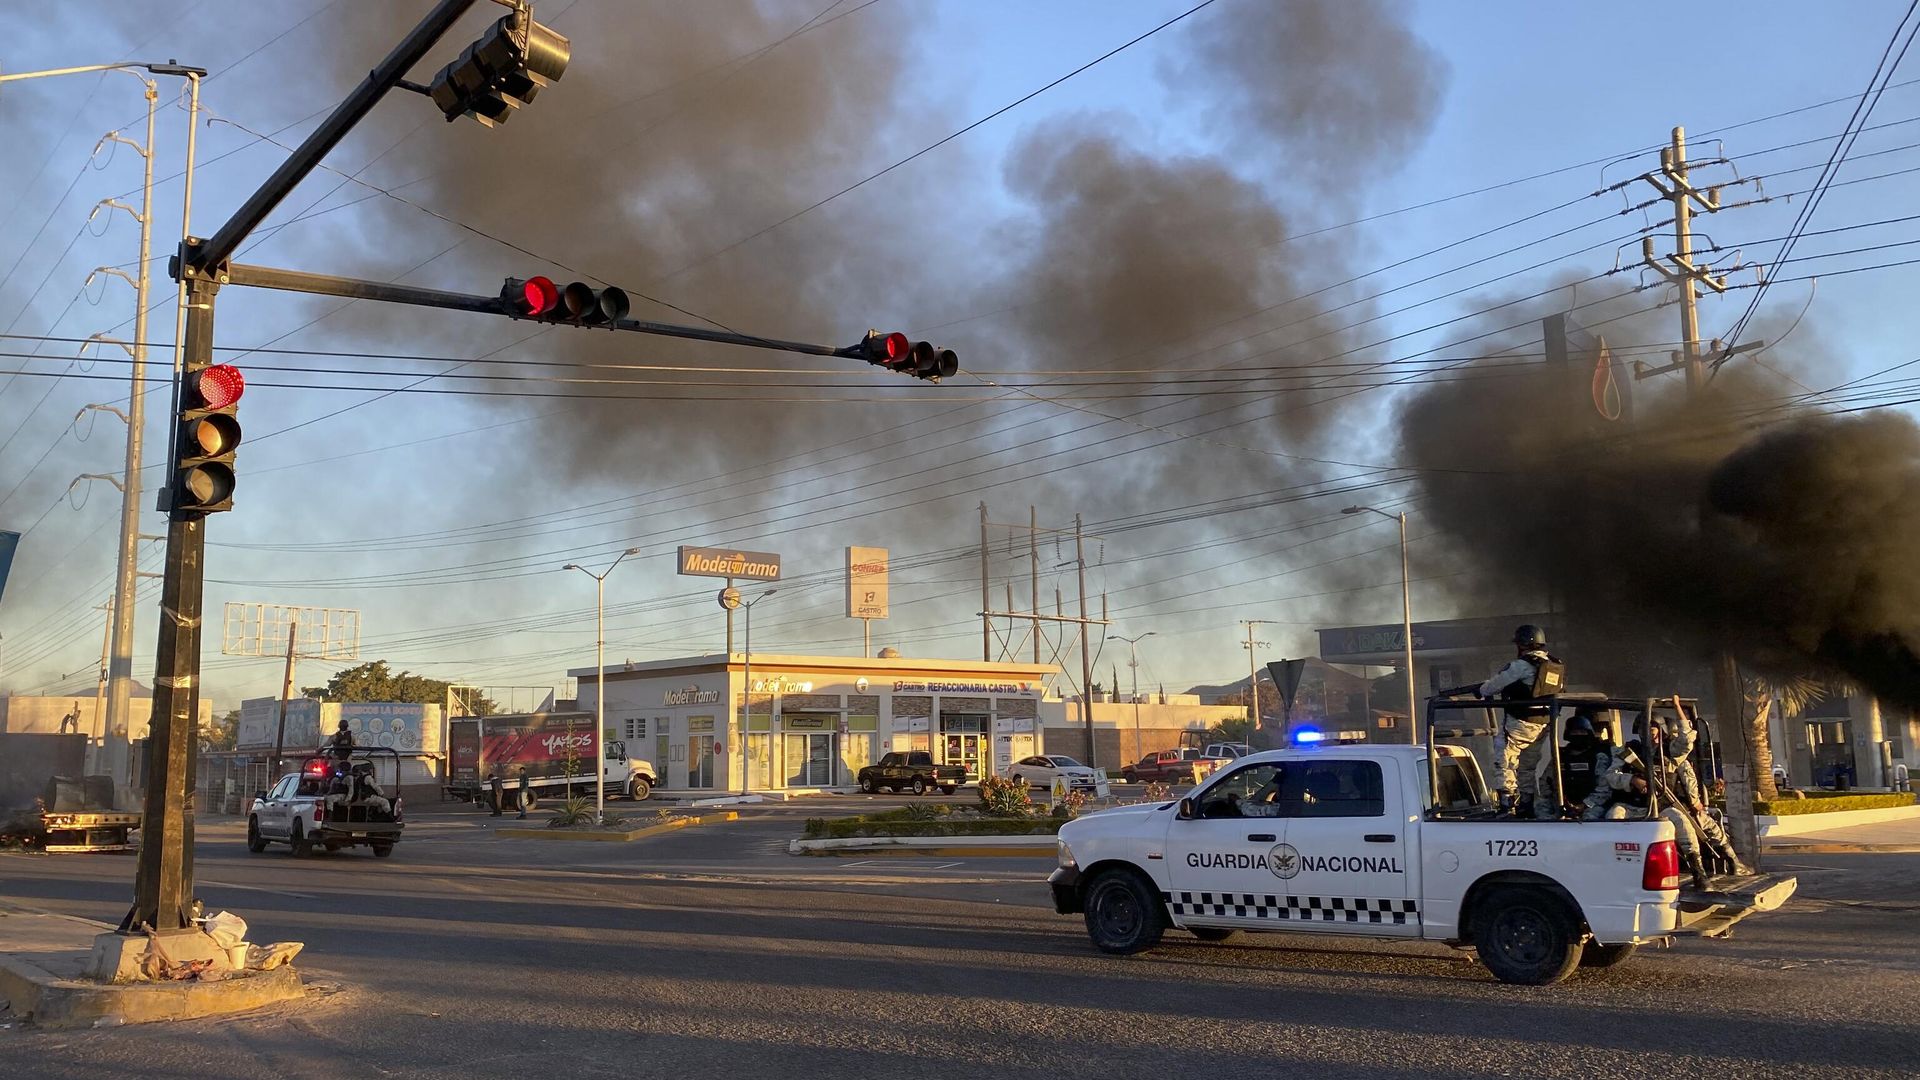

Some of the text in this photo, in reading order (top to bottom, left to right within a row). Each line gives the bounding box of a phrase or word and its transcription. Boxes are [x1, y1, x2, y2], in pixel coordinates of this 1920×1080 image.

[858, 607, 882, 615] CASTRO
[927, 682, 987, 693] REFACCIONARIA
[989, 683, 1018, 694] CASTRO
[1485, 839, 1539, 857] 17223
[1186, 852, 1404, 874] GUARDIA NACIONAL
